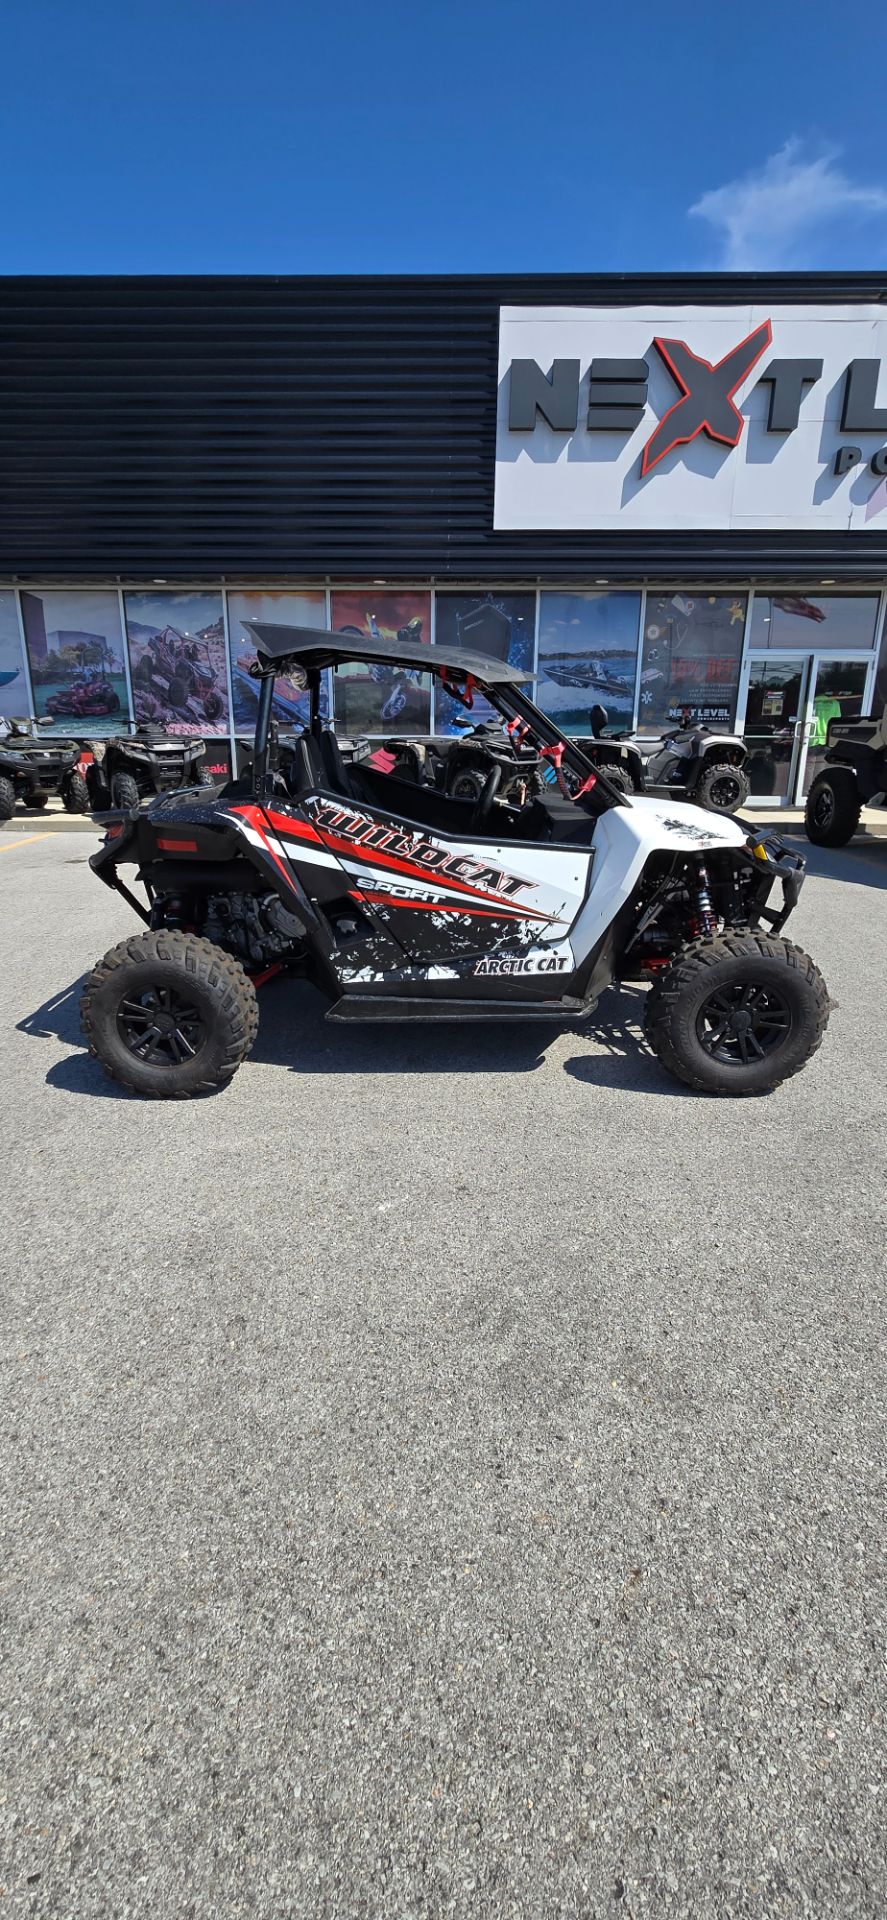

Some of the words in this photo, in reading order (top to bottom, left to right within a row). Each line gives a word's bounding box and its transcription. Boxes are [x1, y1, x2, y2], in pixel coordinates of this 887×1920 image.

[508, 318, 824, 478] NEXT
[668, 706, 697, 717] NEXT
[697, 708, 730, 717] LEVEL
[315, 808, 539, 896] WILDCAT
[355, 877, 446, 905] SPORT
[474, 957, 534, 976] ARCTIC
[536, 956, 570, 974] CAT
